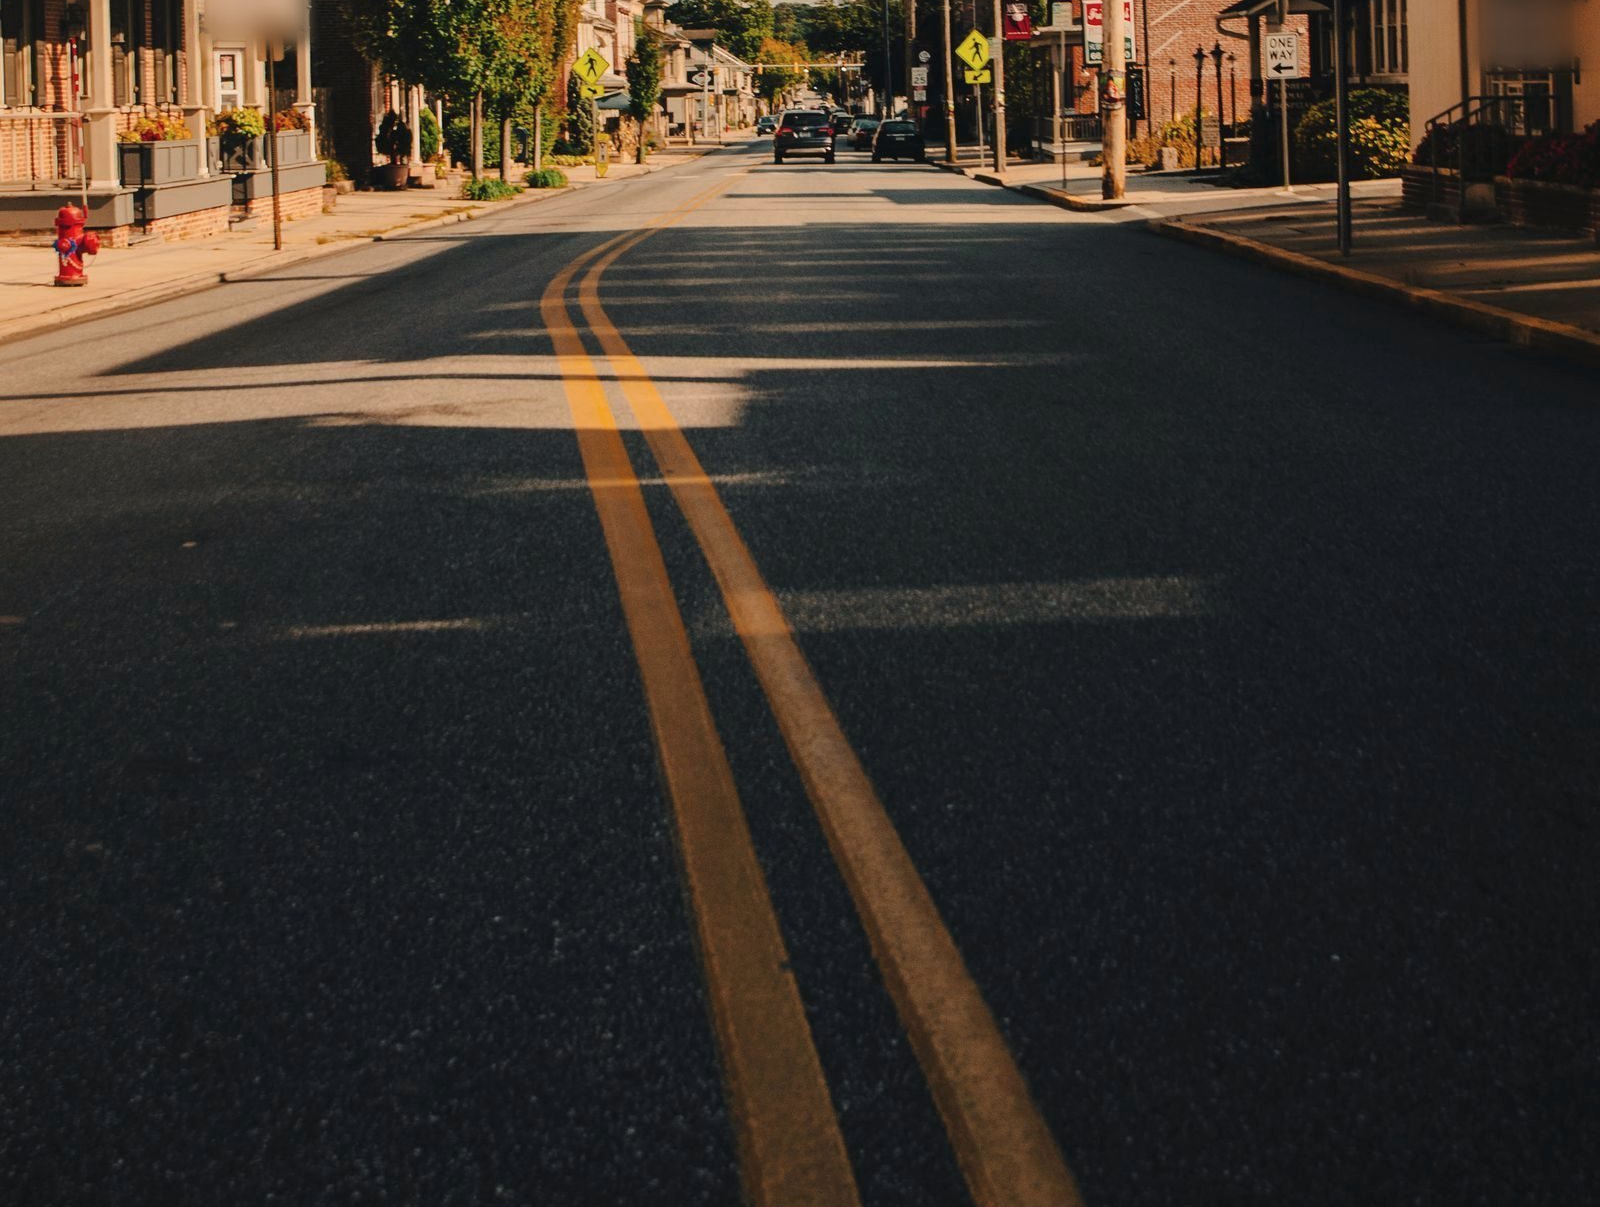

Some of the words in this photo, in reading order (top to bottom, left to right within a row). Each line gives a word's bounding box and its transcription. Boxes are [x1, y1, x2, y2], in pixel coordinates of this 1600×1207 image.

[1270, 37, 1294, 48] ONE
[1270, 49, 1294, 60] WAY
[914, 76, 926, 85] 25
